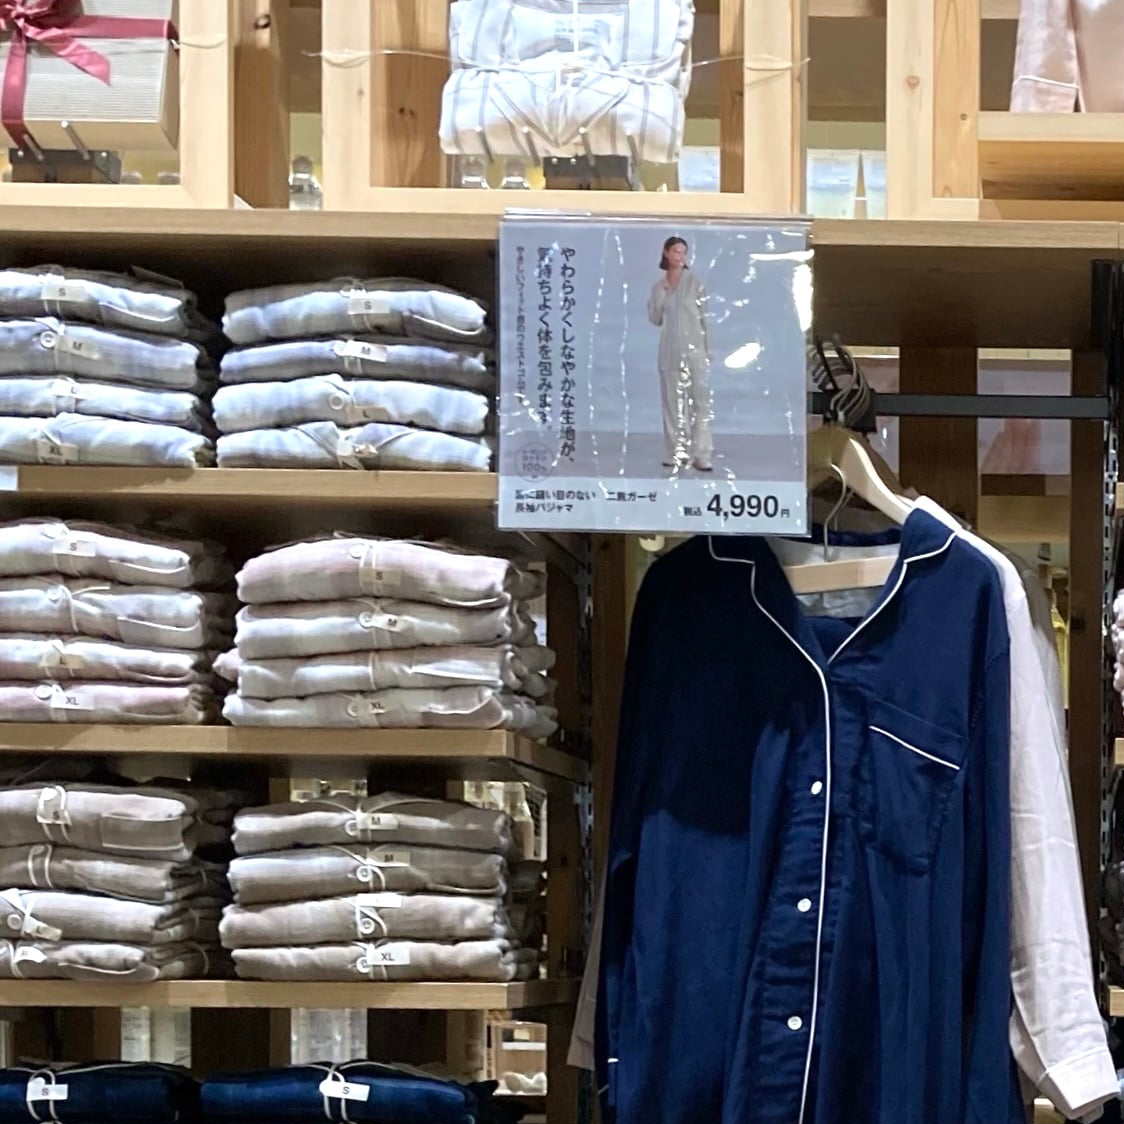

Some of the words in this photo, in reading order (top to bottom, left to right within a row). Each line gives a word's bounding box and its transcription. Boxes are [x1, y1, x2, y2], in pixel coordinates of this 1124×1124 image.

[58, 288, 66, 297] S
[364, 301, 372, 310] S
[72, 341, 82, 350] M
[361, 346, 371, 355] M
[362, 410, 369, 418] L
[49, 446, 62, 456] XL
[69, 542, 77, 551] S
[376, 571, 383, 580] S
[387, 618, 397, 627] M
[59, 656, 66, 665] L
[66, 697, 79, 706] XL
[371, 816, 380, 825] M
[384, 854, 394, 862] M
[381, 953, 394, 961] XL
[41, 1087, 49, 1096] S
[343, 1086, 350, 1095] S
